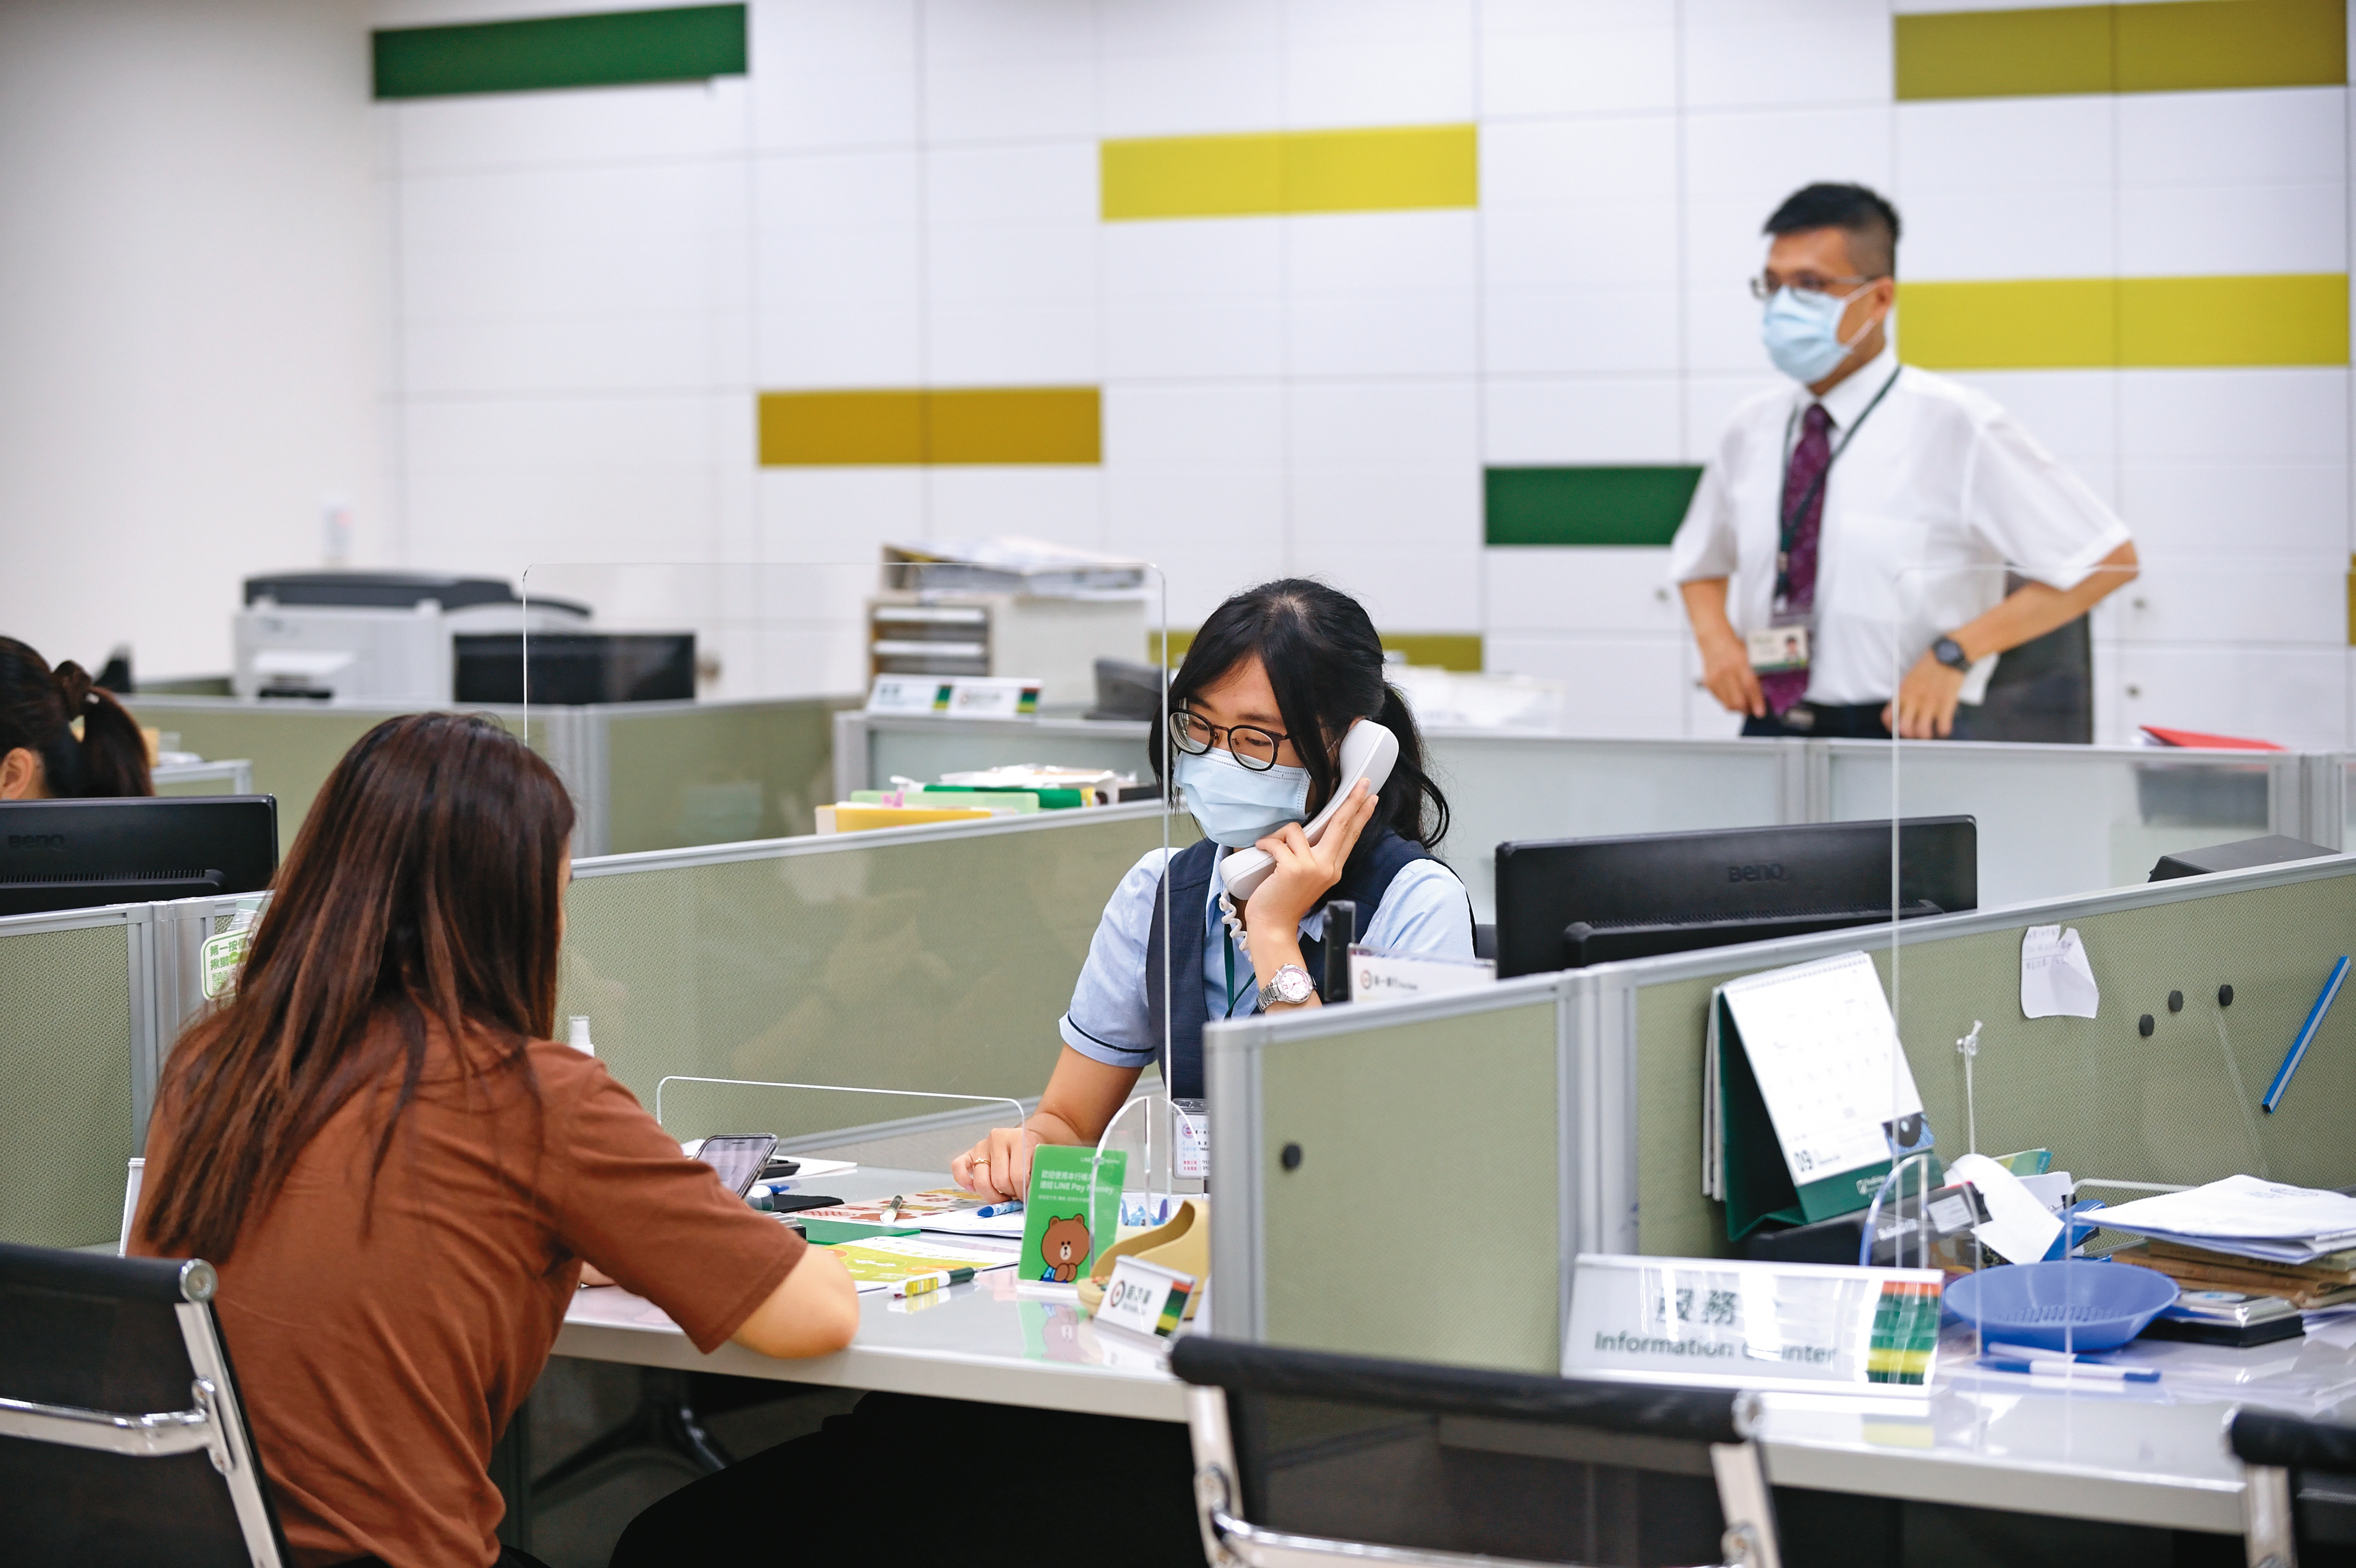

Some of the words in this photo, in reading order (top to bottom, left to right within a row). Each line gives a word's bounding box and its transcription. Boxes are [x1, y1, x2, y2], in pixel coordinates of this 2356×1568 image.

[1071, 1183, 1085, 1193] Pay
[1594, 1330, 1734, 1358] Information
[1742, 1340, 1837, 1364] Cnter
